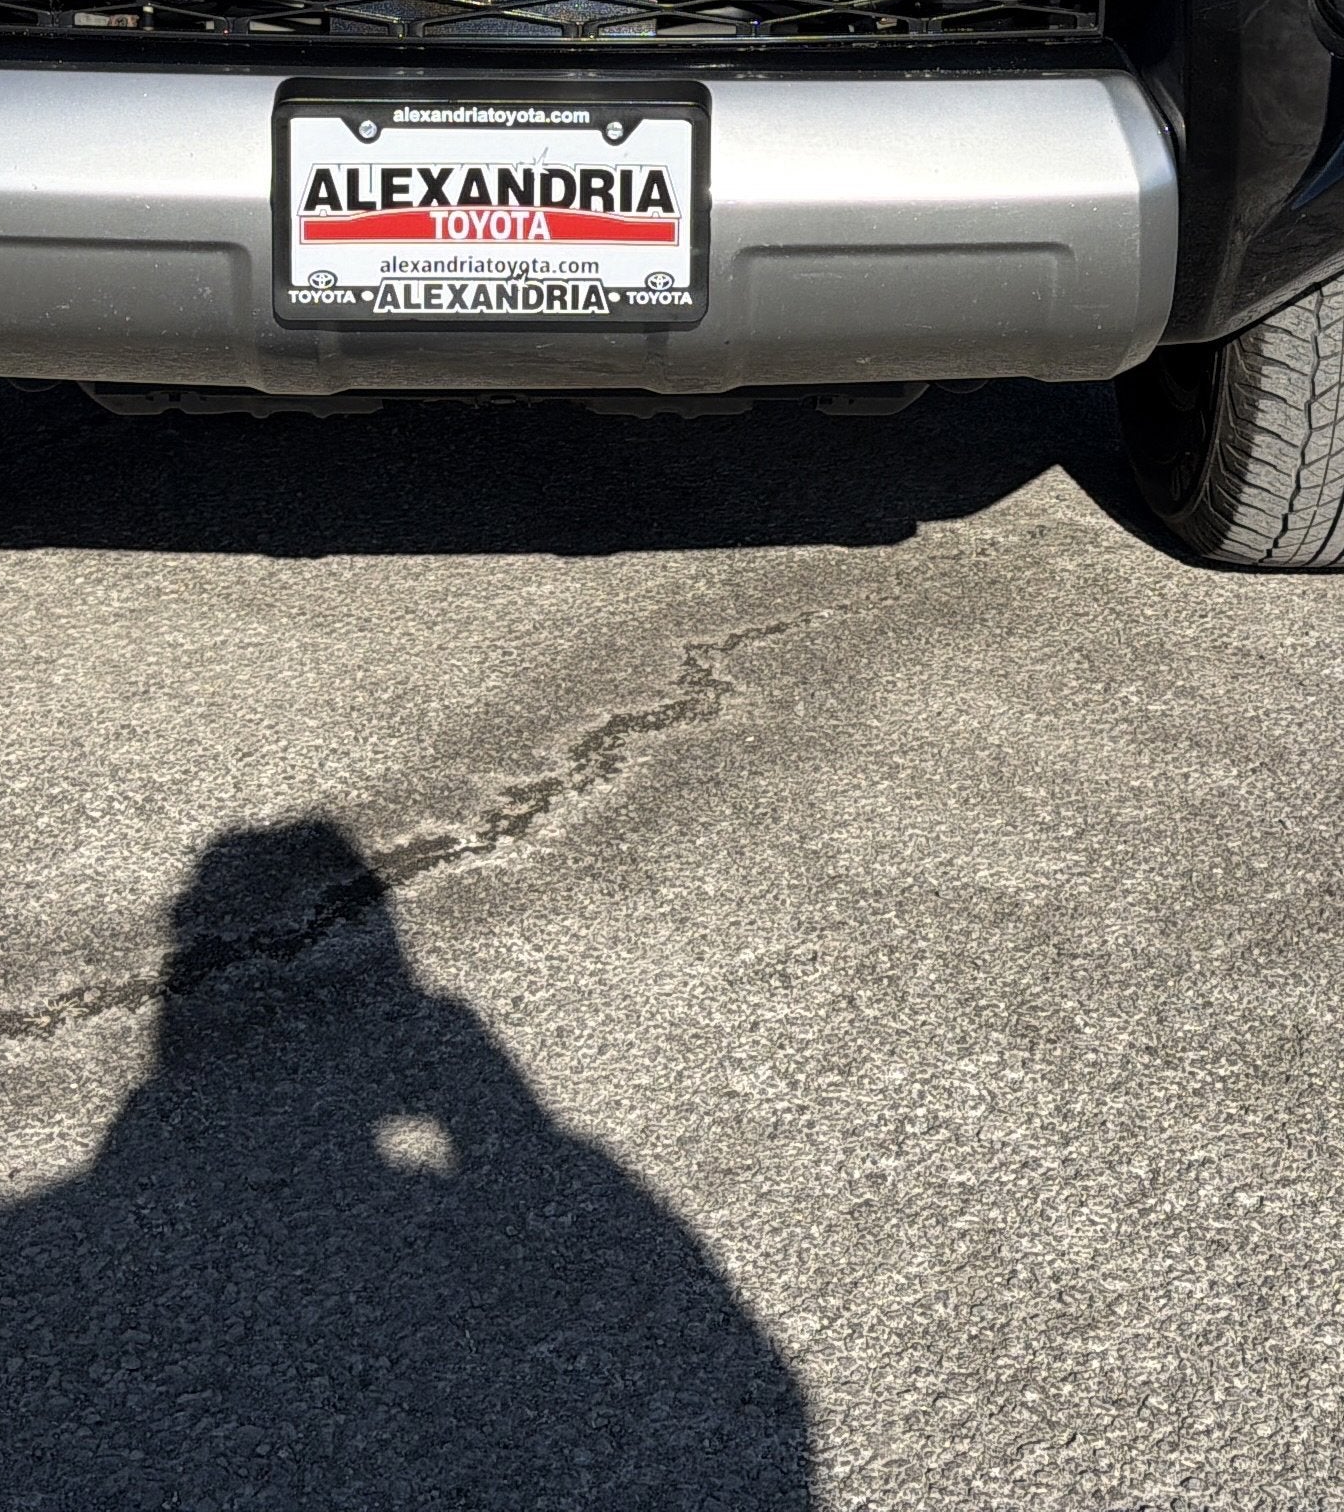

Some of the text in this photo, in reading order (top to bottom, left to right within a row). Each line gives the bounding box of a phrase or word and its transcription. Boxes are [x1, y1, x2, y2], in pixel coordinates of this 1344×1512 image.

[392, 106, 590, 126] alexandriatoyota.com
[302, 166, 676, 215] ALEXANDRIA
[429, 210, 552, 240] TOYOTA
[379, 255, 600, 276] alexandriatoyota.com
[288, 281, 693, 312] TOYOTA ALEXANDRIA TOYOTA
